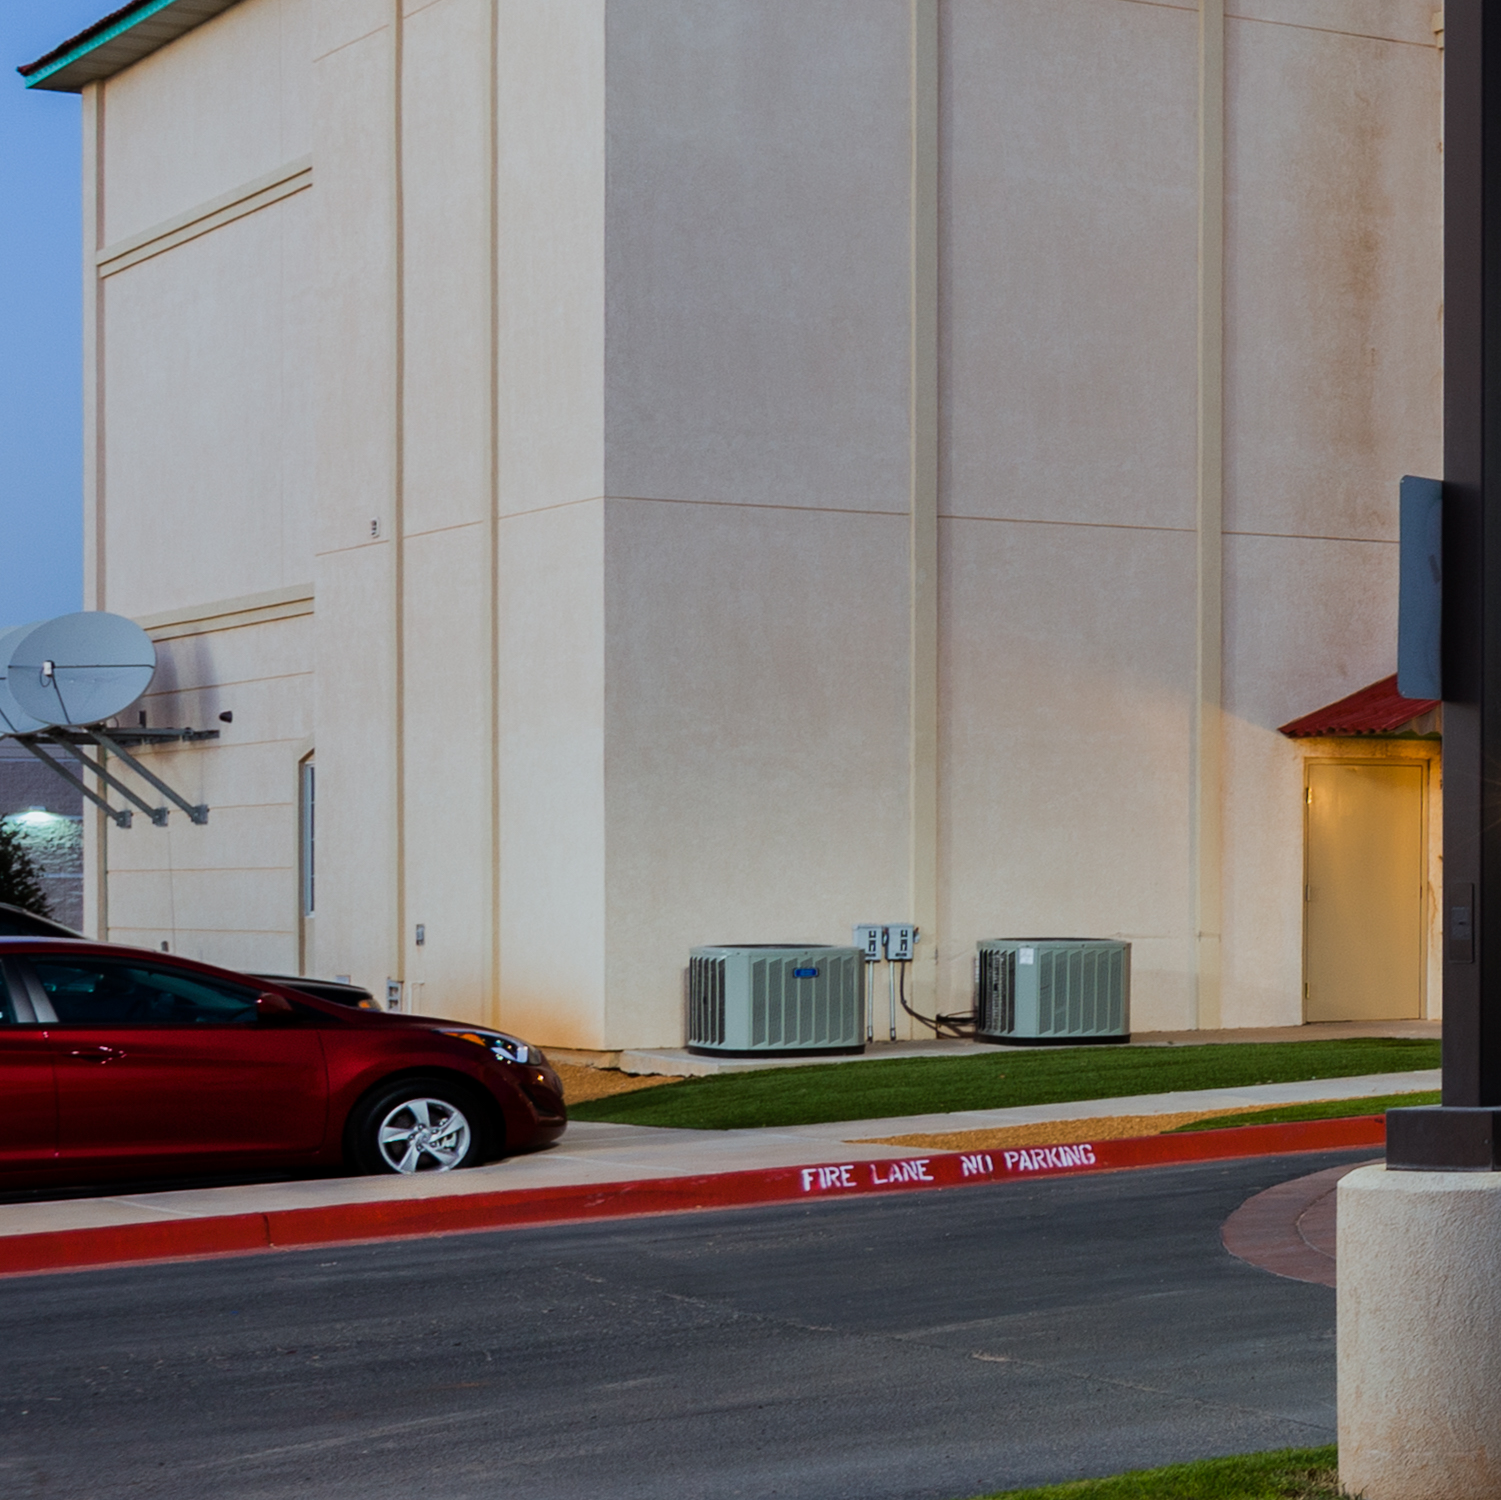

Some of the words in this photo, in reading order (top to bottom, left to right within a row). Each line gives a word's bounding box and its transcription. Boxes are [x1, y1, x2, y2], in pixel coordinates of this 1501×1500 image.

[801, 1165, 857, 1192] FIRE
[869, 1159, 934, 1185] LANE
[960, 1154, 993, 1178] NO
[1004, 1144, 1097, 1172] PARKING
